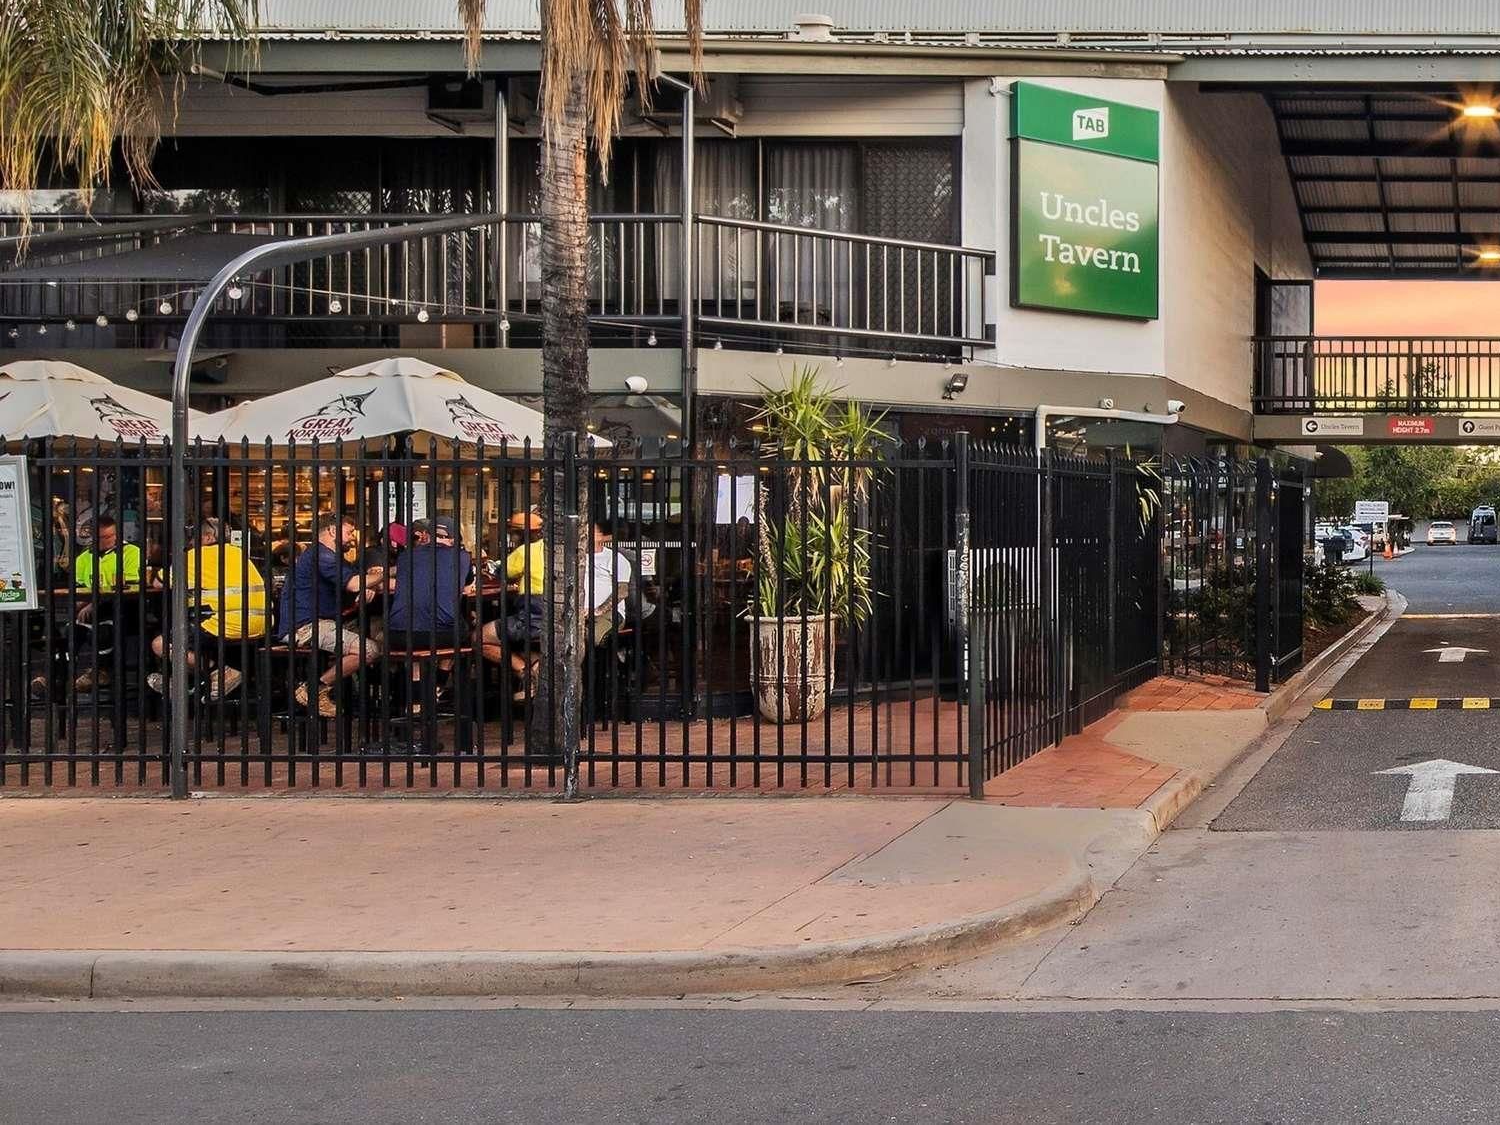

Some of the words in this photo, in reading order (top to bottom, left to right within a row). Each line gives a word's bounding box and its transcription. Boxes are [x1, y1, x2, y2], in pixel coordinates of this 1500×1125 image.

[1077, 114, 1105, 133] TAB
[1040, 191, 1140, 232] Uncles
[1039, 234, 1141, 273] Tavern
[301, 416, 356, 429] GREAT
[285, 427, 354, 438] NORTHERN
